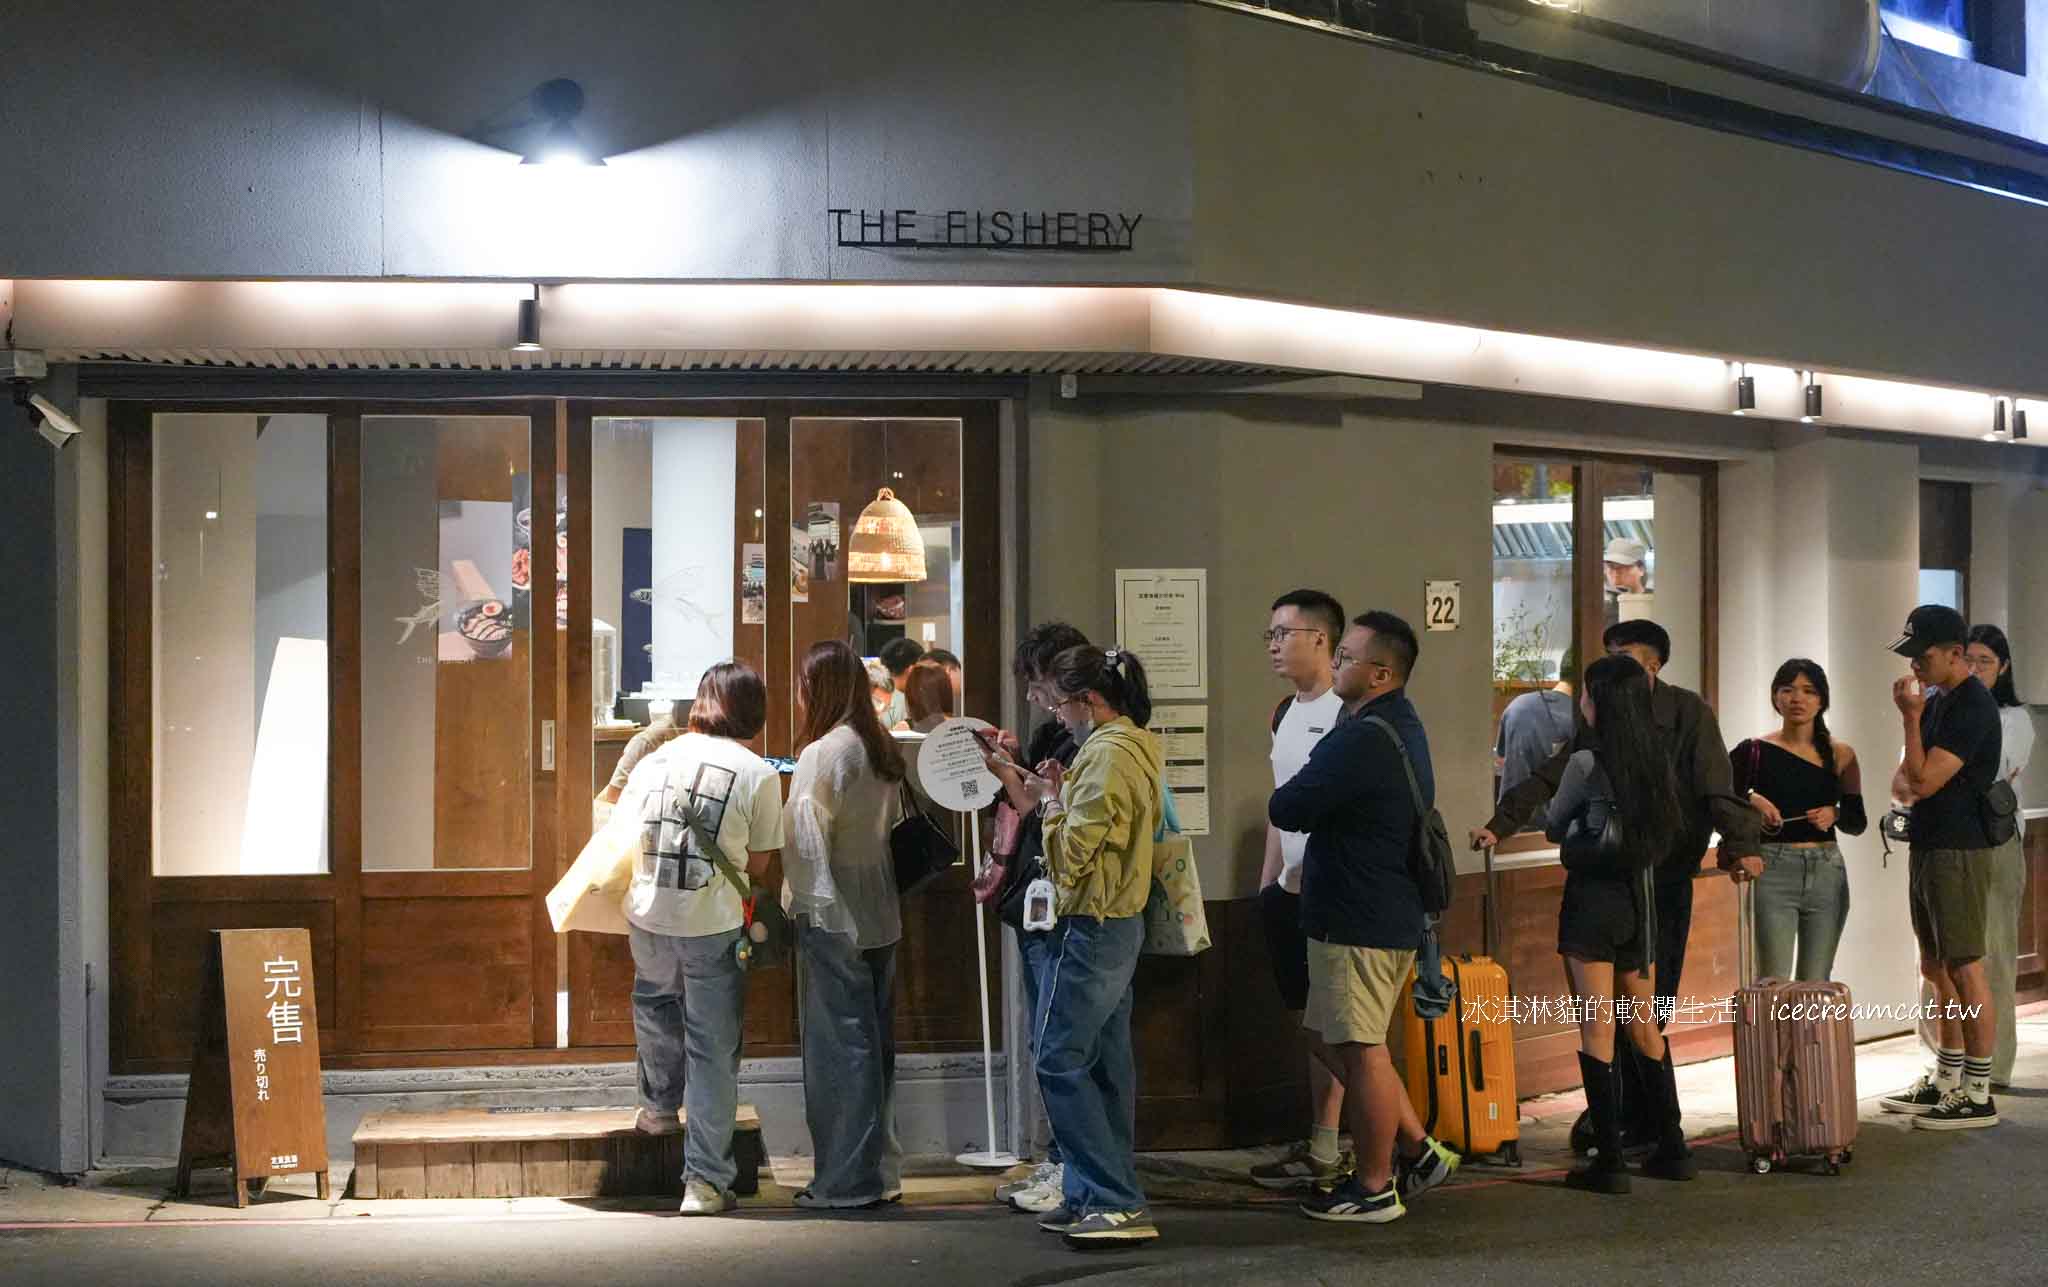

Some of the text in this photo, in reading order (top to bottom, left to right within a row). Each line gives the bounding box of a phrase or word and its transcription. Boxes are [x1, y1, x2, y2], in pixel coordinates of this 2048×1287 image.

[828, 209, 1143, 249] THE FISHERY
[1432, 597, 1454, 624] 22
[263, 955, 303, 1044] 完售
[253, 1048, 270, 1102] 売り切れ
